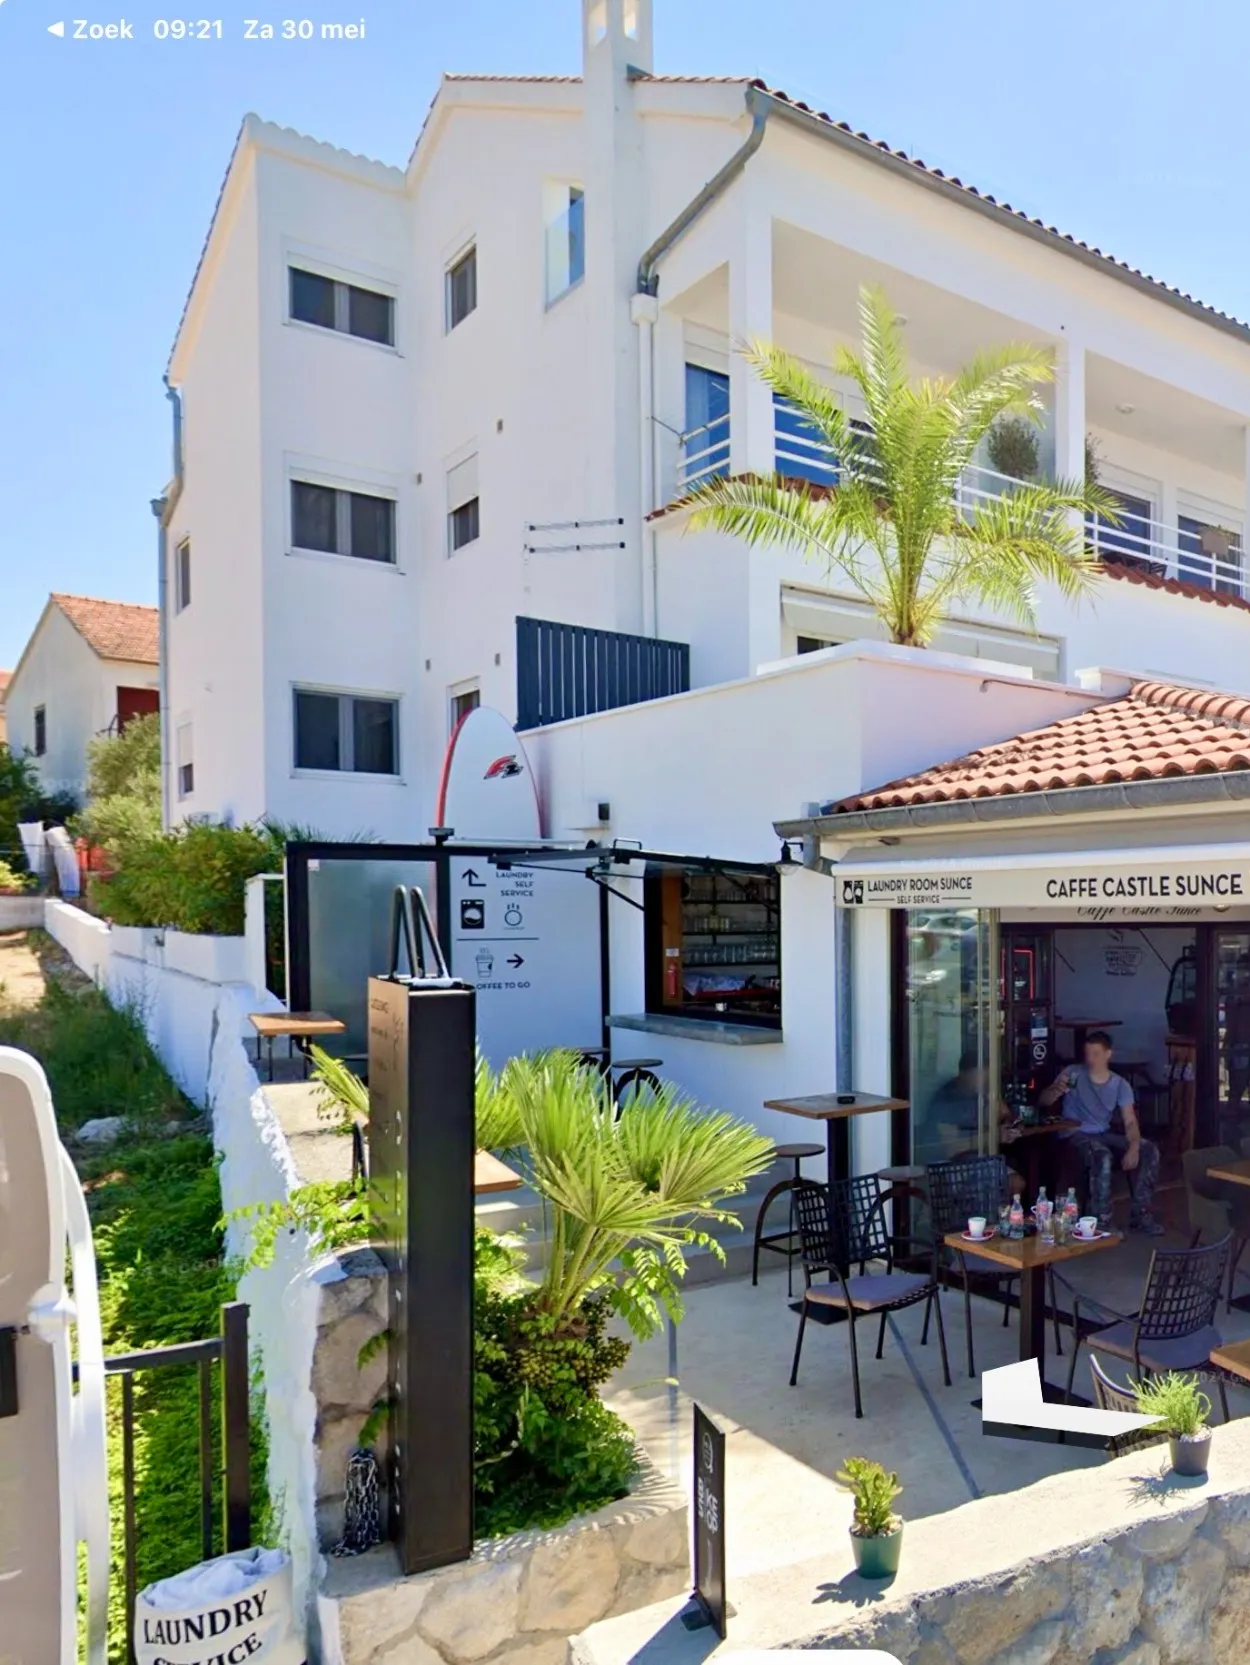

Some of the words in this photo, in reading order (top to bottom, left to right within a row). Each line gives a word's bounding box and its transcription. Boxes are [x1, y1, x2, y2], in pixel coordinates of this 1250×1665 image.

[495, 871, 534, 879] LAUNDRY
[867, 879, 908, 892] LAUNDRY
[910, 878, 938, 891] ROOM
[941, 877, 972, 890] SUNCE
[1046, 877, 1099, 900] CAFFE
[1103, 875, 1170, 898] CASTLE
[1175, 873, 1242, 896] SUNCE
[897, 895, 912, 904] SELF
[913, 895, 940, 904] SERVICE
[476, 981, 502, 990] OFFEE
[505, 981, 515, 989] TO
[517, 981, 531, 989] GO
[143, 1588, 269, 1646] LAUNDRY
